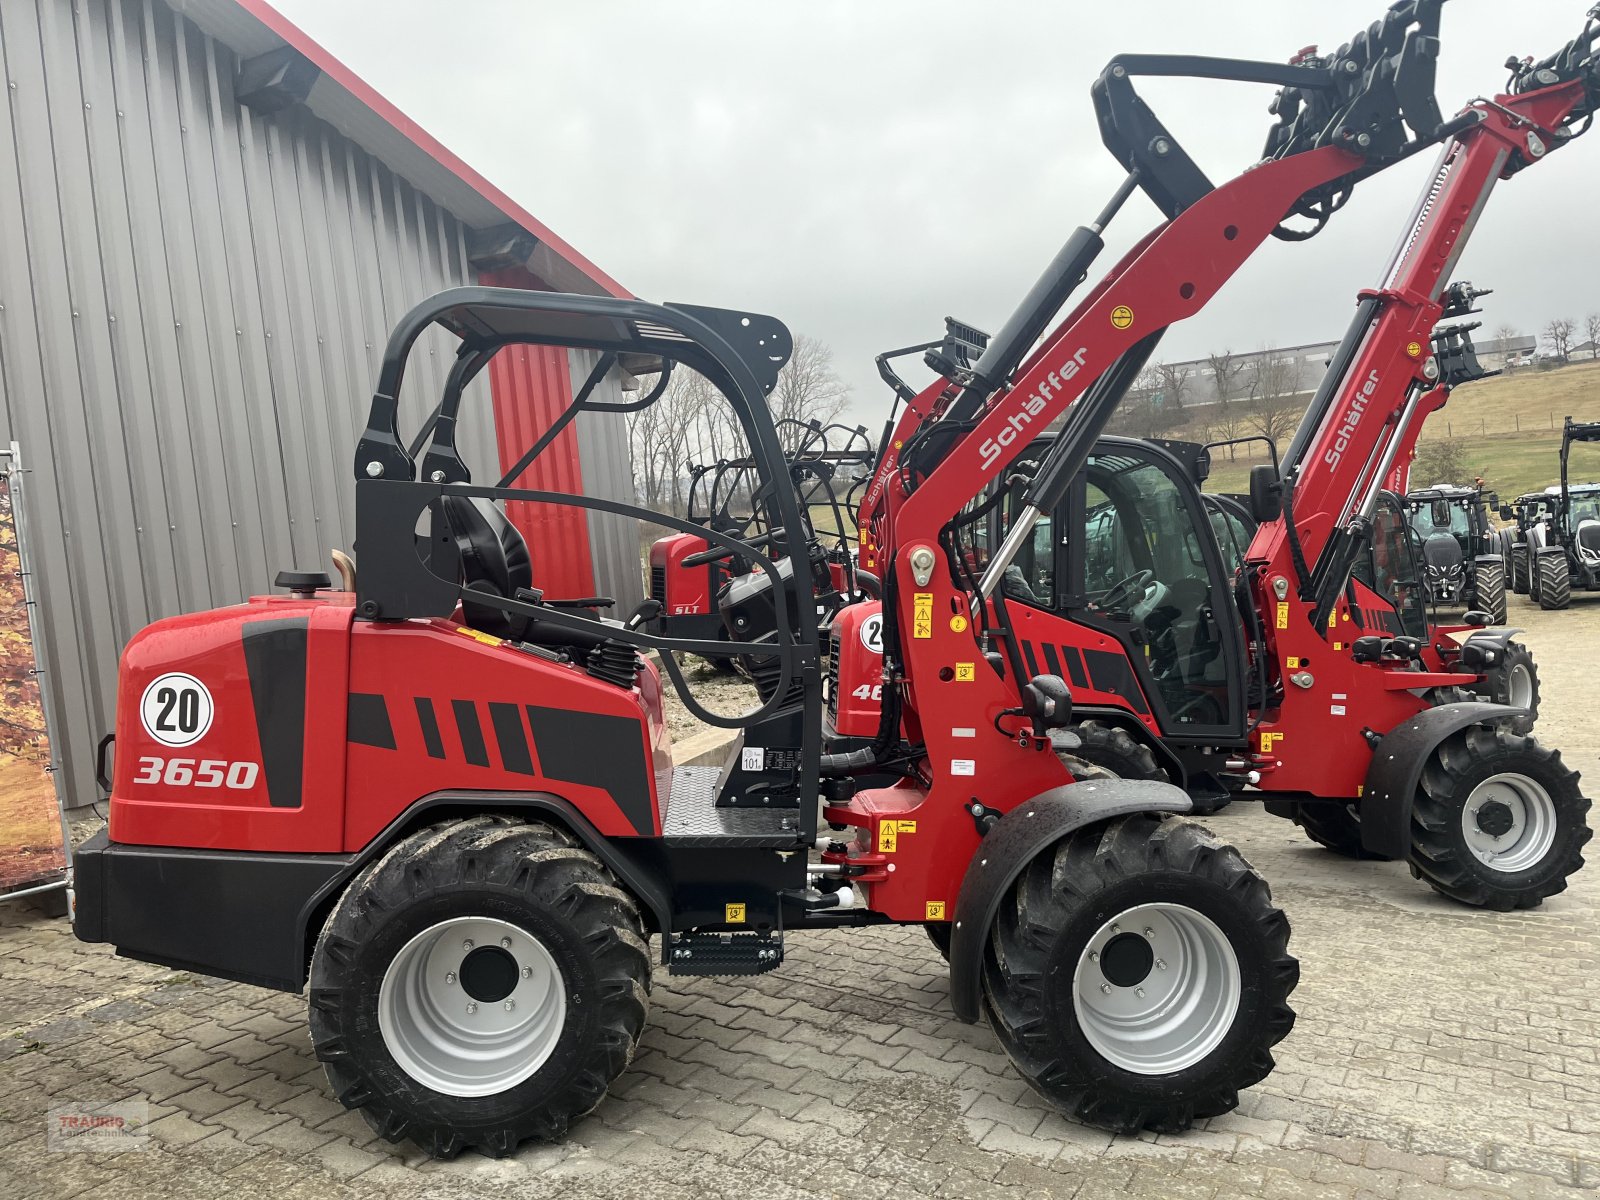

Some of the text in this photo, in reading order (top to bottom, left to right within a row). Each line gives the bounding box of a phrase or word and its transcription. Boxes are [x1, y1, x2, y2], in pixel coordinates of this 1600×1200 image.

[979, 347, 1088, 471] Schäffer
[1324, 369, 1379, 473] Schäffer
[675, 606, 699, 615] SLT
[156, 687, 199, 733] 20
[133, 756, 259, 790] 3650
[744, 757, 758, 769] 101
